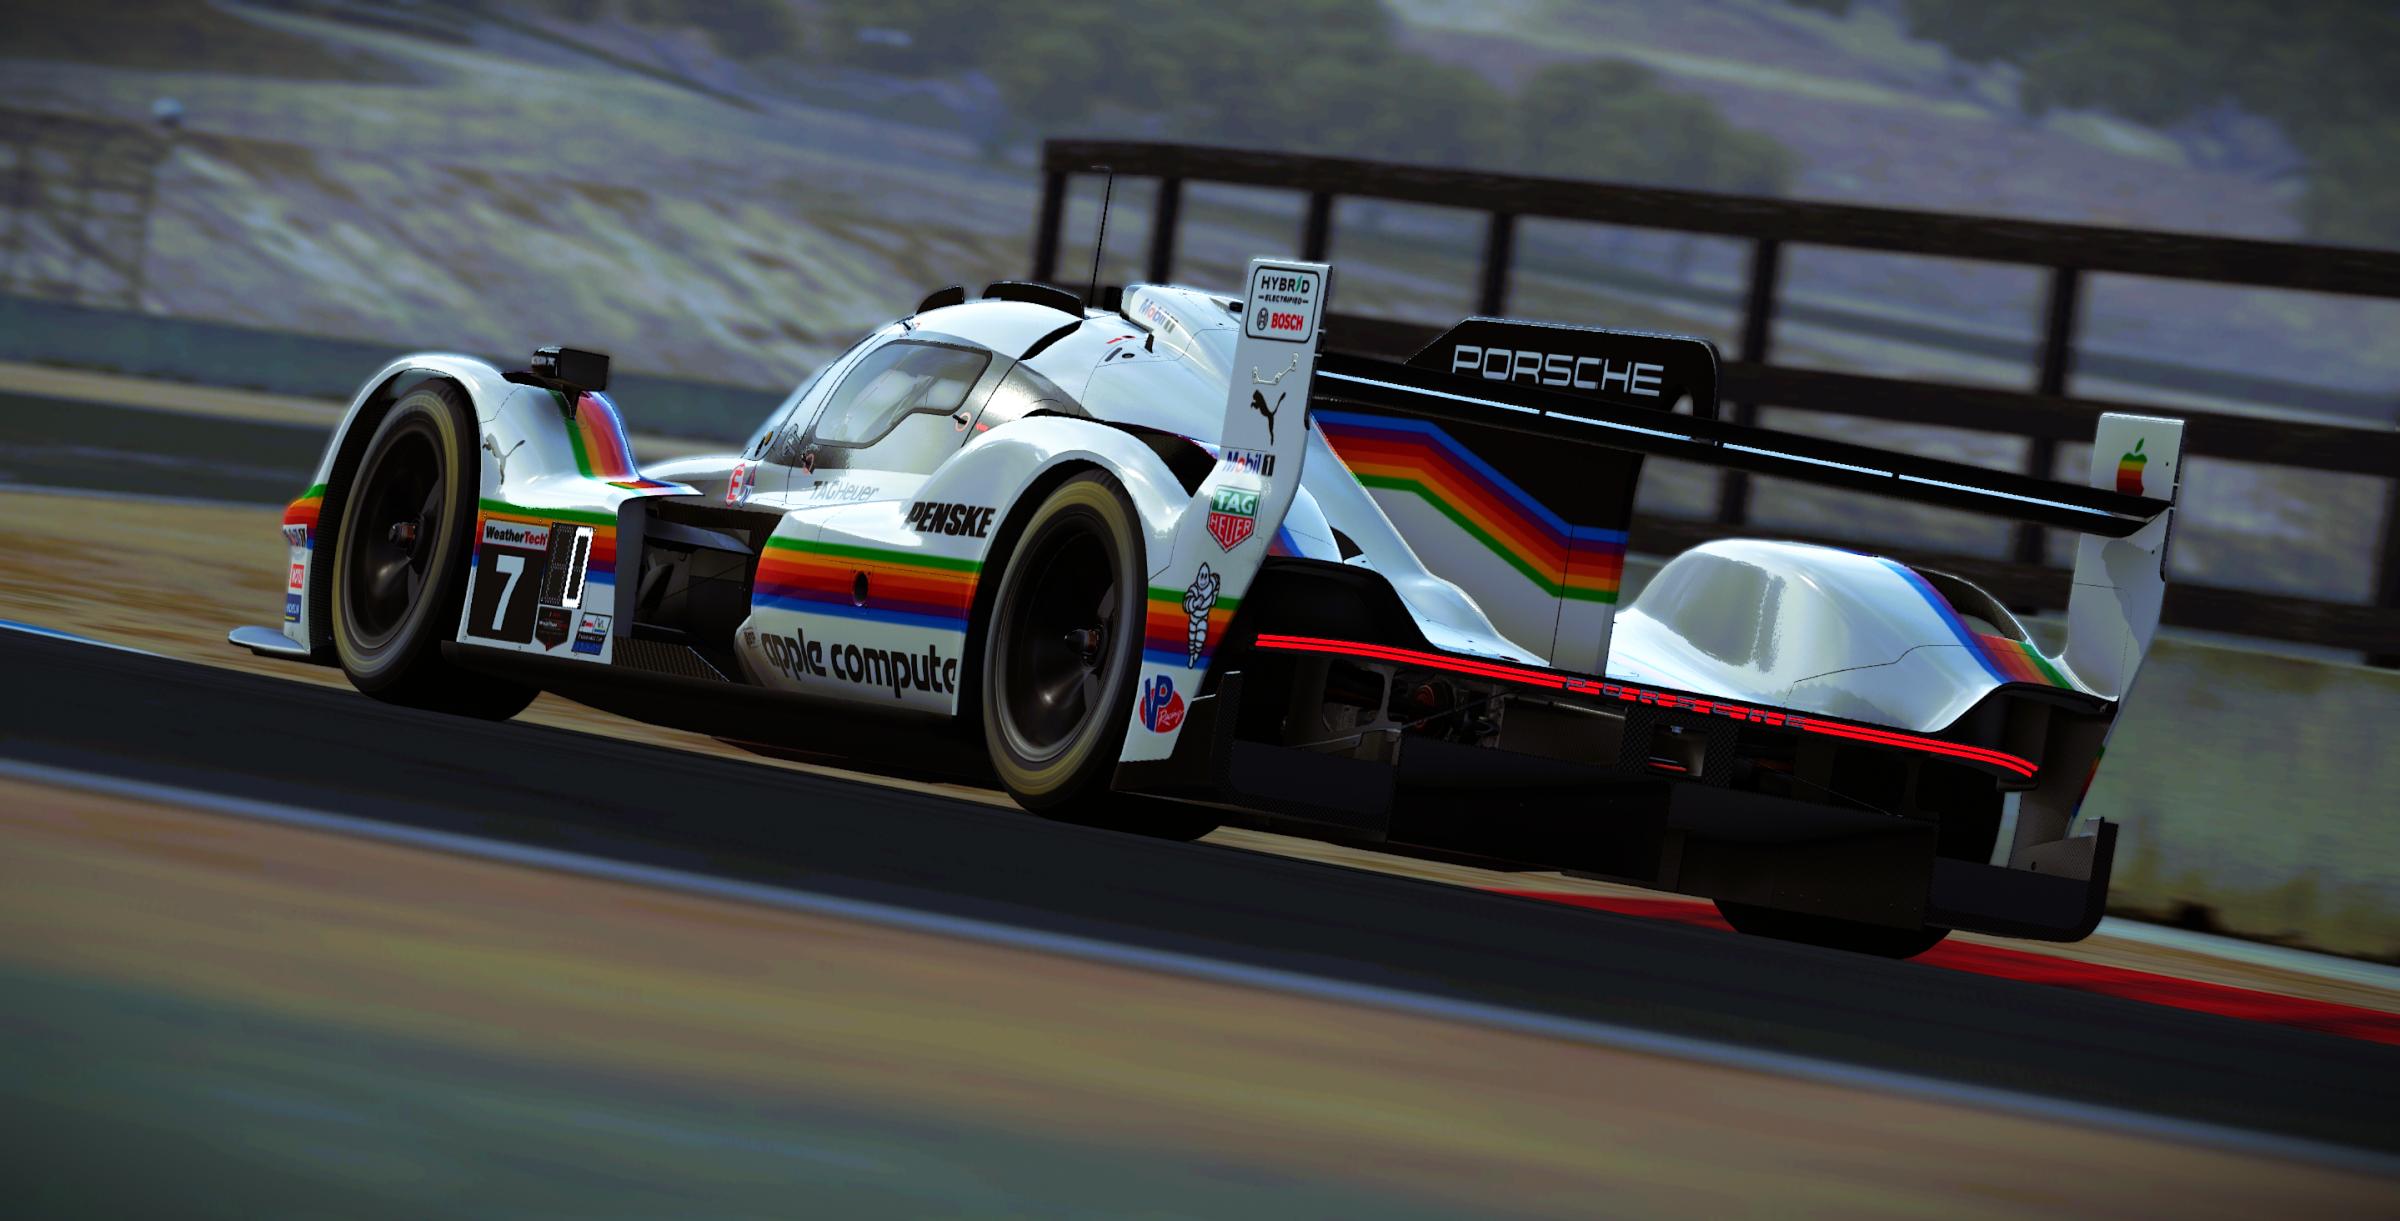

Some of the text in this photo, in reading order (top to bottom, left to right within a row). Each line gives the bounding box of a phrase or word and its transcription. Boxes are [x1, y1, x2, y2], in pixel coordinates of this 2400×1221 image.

[1261, 275, 1310, 294] HYBRID
[1271, 312, 1304, 331] BOSCH
[1452, 344, 1664, 397] PORSCHE
[1222, 451, 1261, 474] Mobil
[1216, 490, 1255, 514] TAG
[485, 525, 548, 546] WeatherTech
[901, 501, 996, 538] PENSKE
[1208, 513, 1253, 545] HEUER
[491, 554, 526, 631] 7
[760, 628, 827, 682] apple
[1144, 674, 1174, 733] VP
